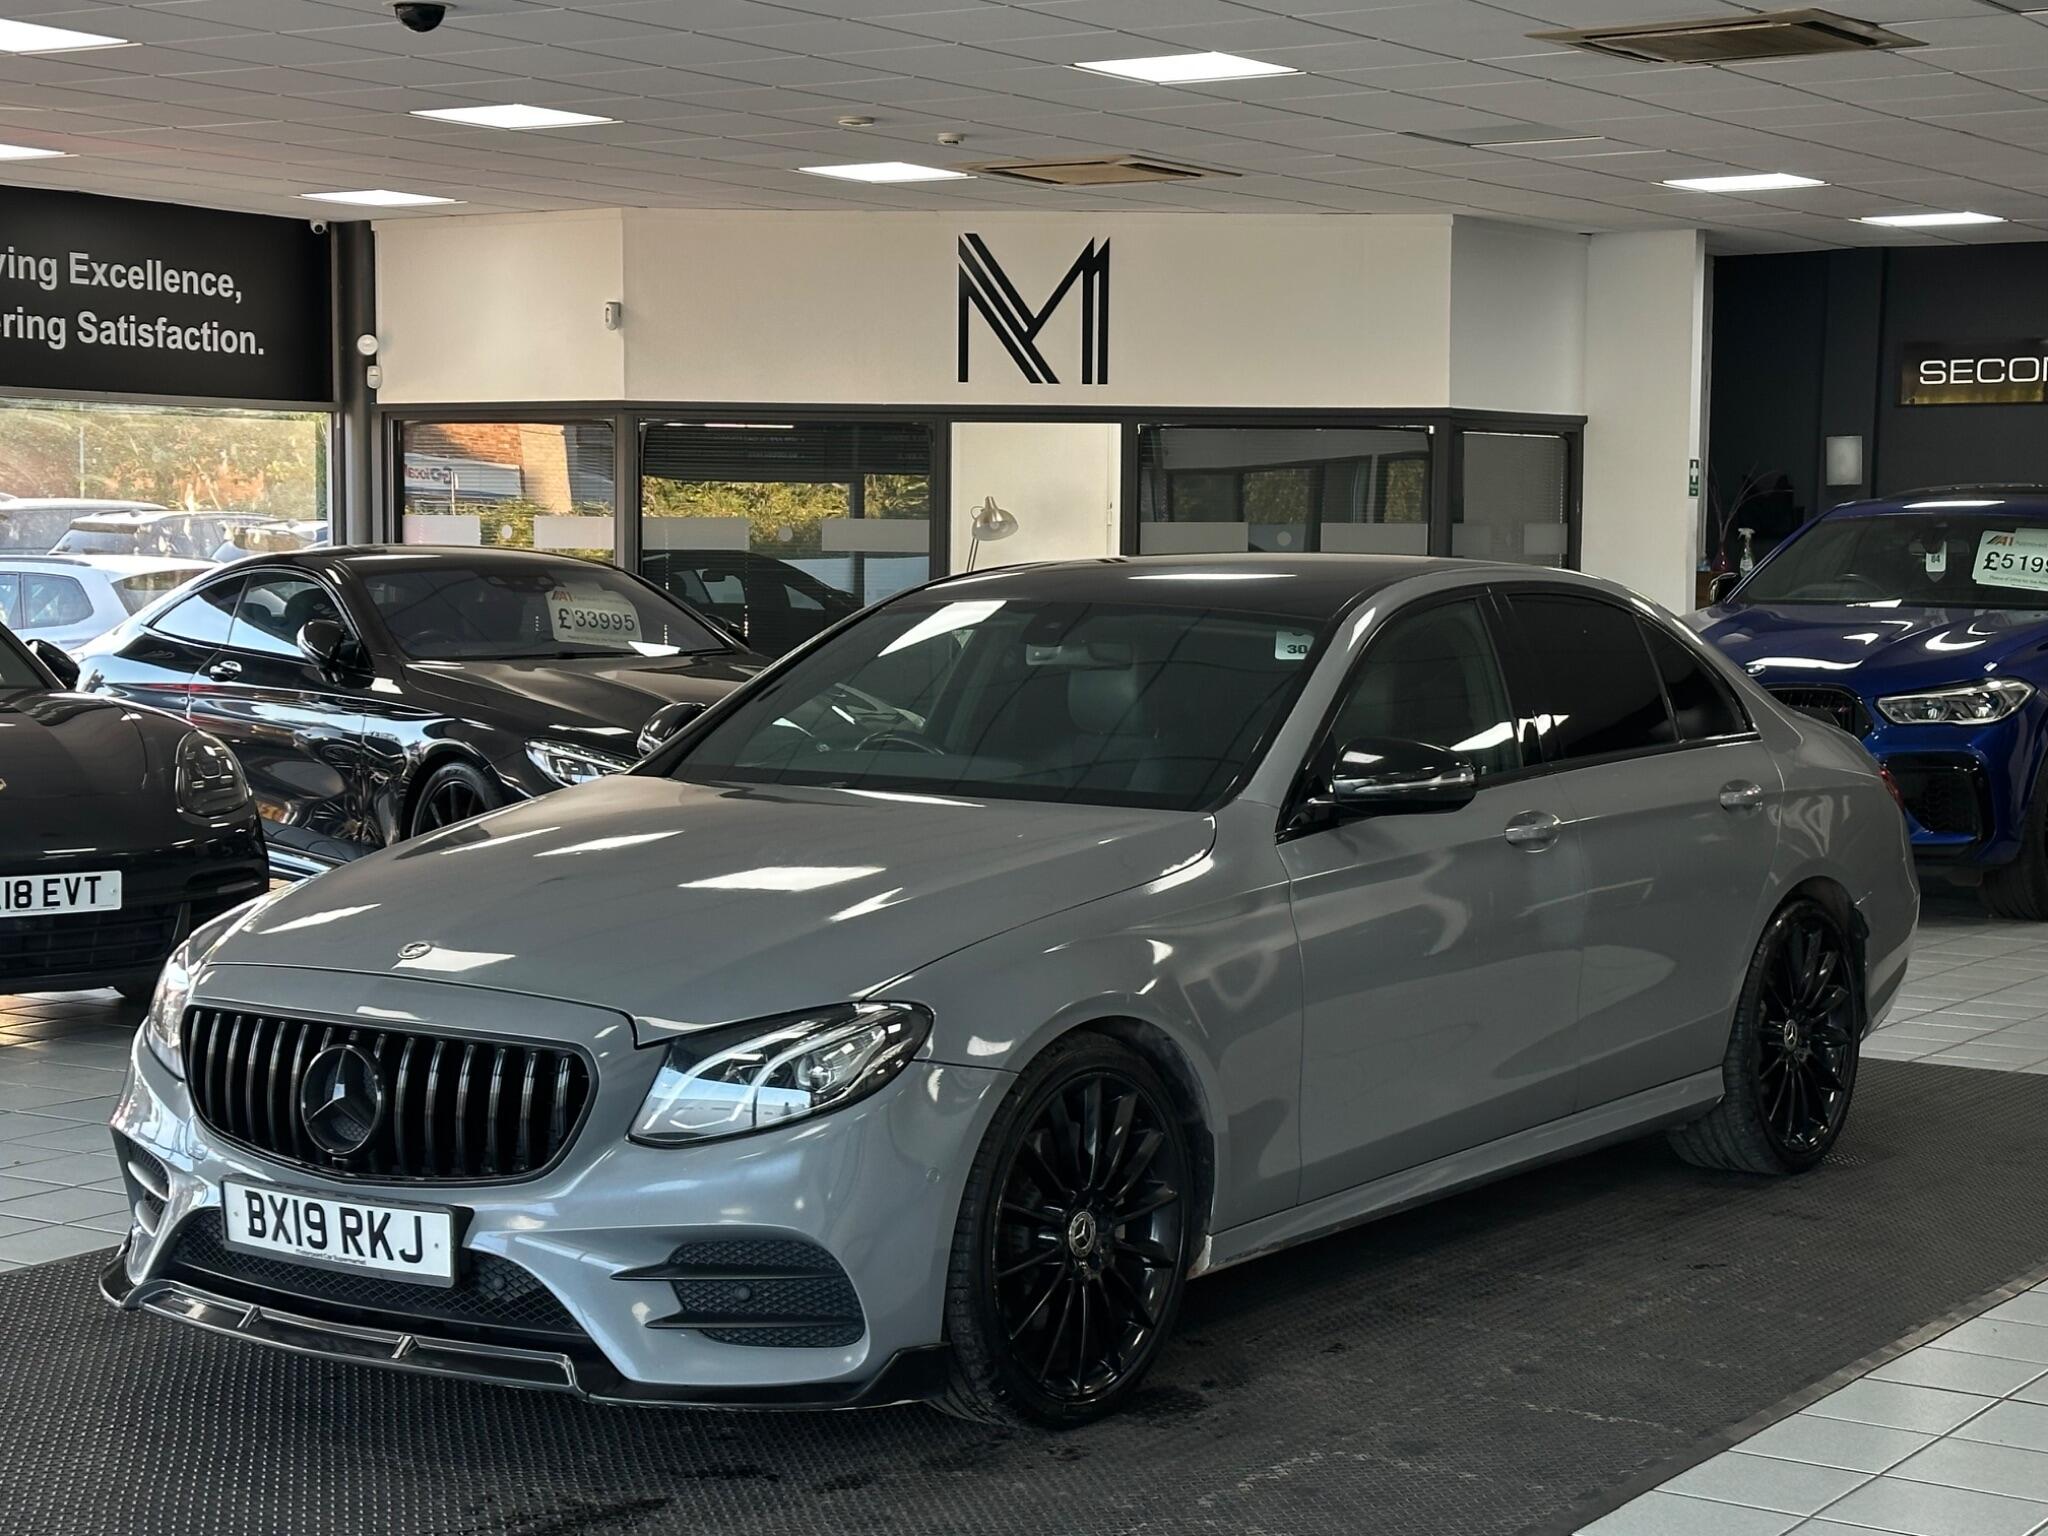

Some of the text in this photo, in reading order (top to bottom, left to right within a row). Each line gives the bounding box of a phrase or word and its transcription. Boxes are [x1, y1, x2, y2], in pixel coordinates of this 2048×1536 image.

[69, 251, 242, 304] Excellence,
[0, 306, 264, 355] ring Satisfaction.
[1919, 357, 2048, 385] SECO
[1983, 551, 2048, 573] £519
[1287, 644, 1308, 654] 30
[0, 876, 101, 910] 18 EVT
[245, 1190, 424, 1263] BX19 RKJ
